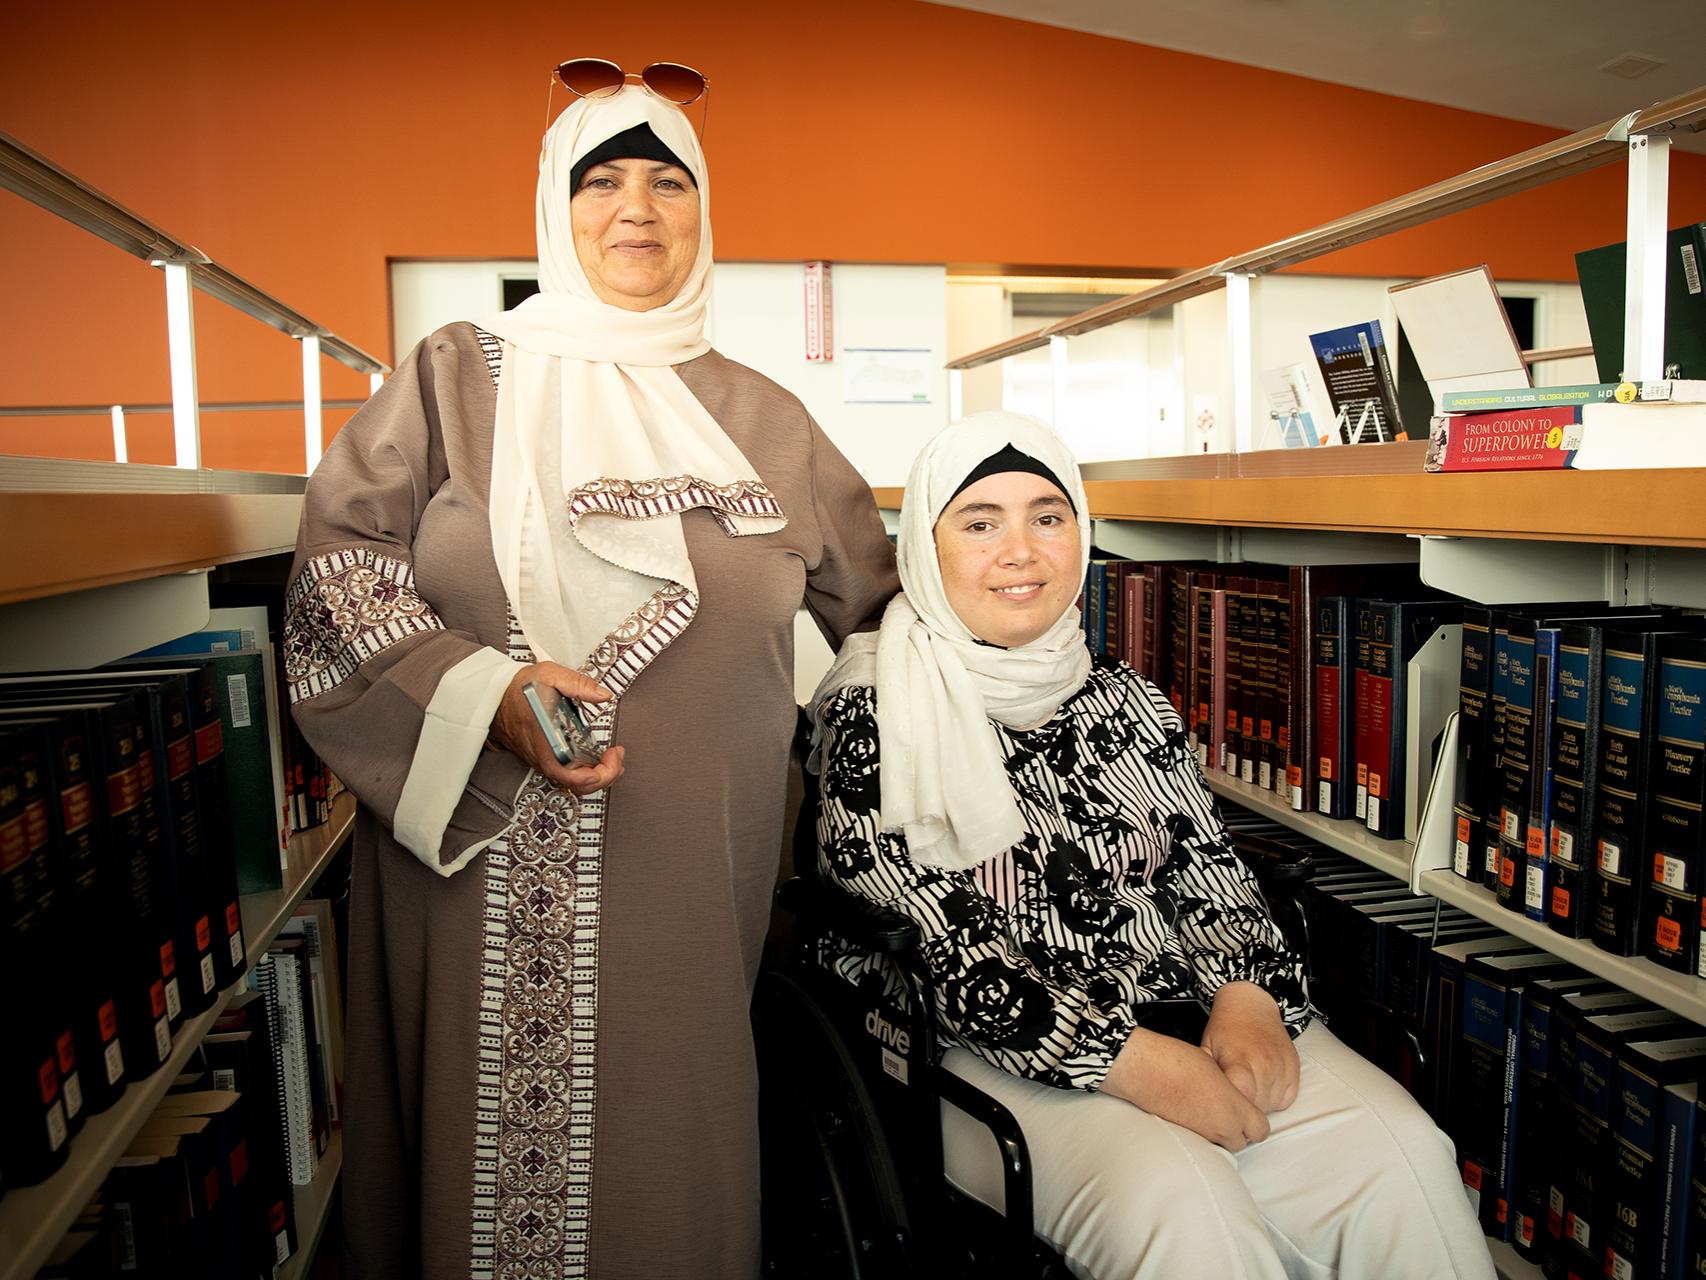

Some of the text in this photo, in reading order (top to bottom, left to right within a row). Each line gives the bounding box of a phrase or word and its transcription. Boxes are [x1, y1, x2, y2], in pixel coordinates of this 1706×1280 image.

[1504, 395, 1537, 403] CULTURAL
[1465, 419, 1552, 436] FROM COLONY TO
[1462, 433, 1551, 453] SUPERPOWER
[1665, 748, 1694, 765] Discovery
[1666, 761, 1692, 775] Practice
[1602, 881, 1609, 898] 4
[1664, 898, 1673, 915] 5
[865, 1008, 911, 1055] drive
[1616, 1201, 1638, 1228] 16B
